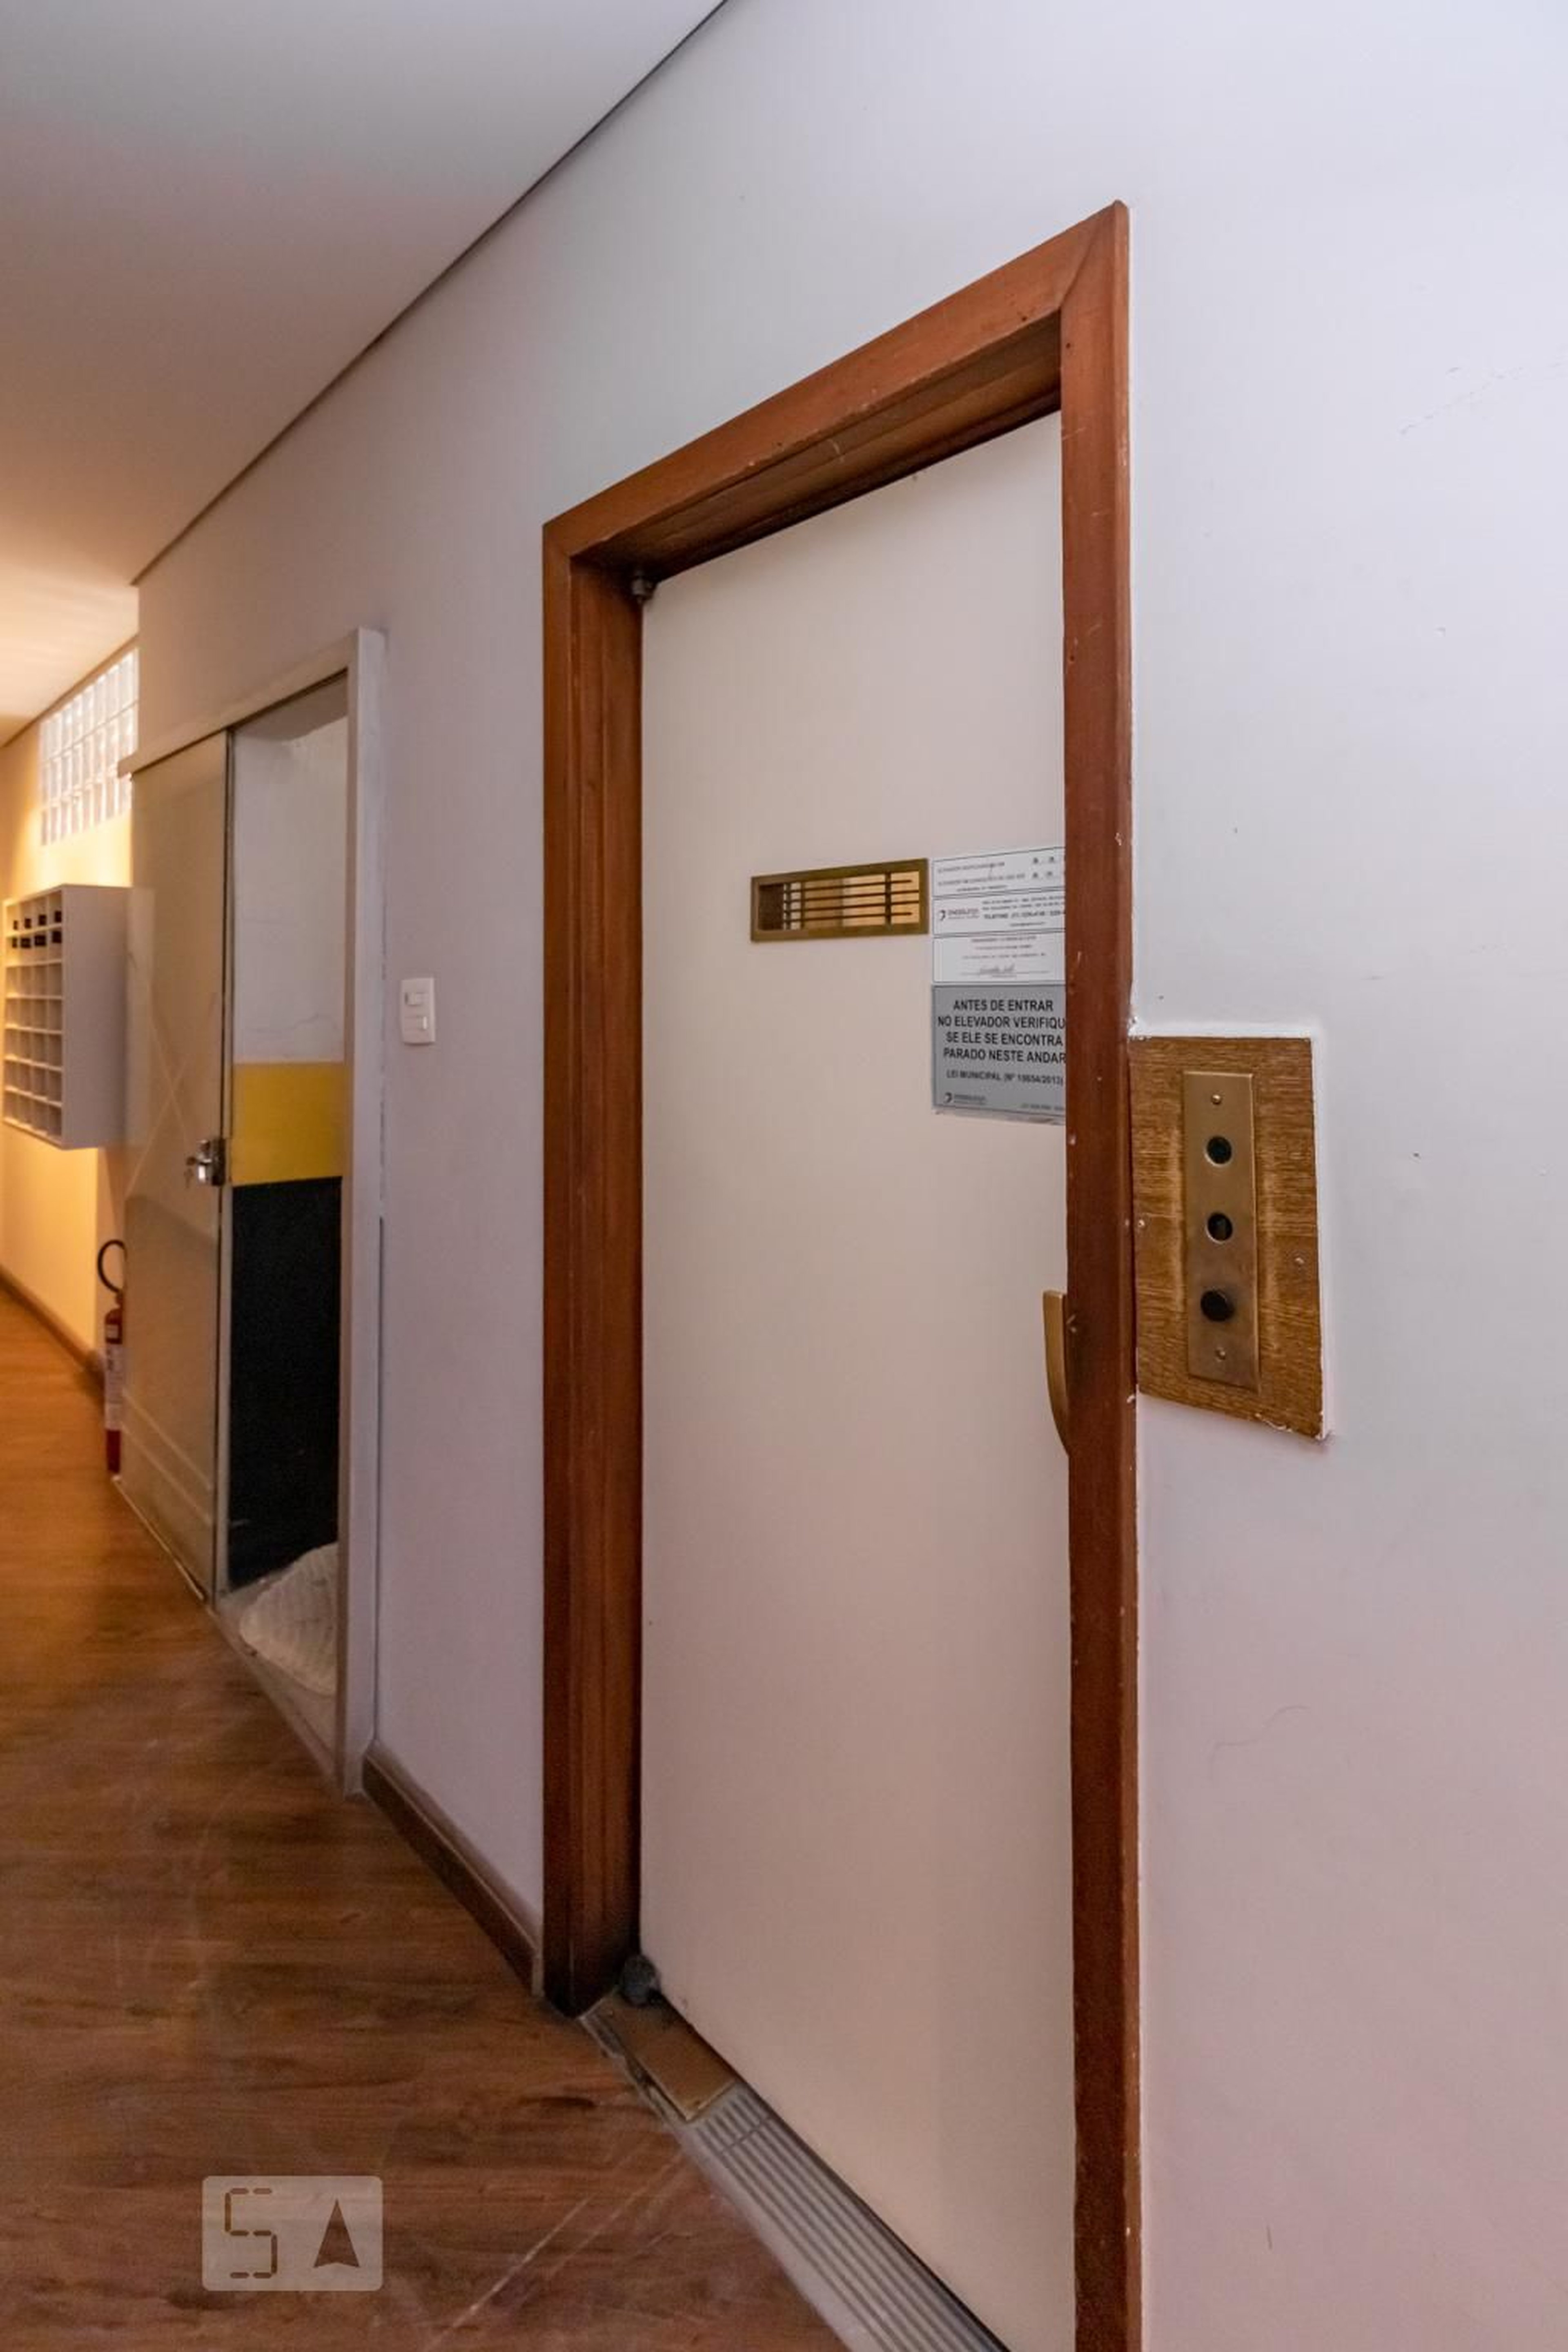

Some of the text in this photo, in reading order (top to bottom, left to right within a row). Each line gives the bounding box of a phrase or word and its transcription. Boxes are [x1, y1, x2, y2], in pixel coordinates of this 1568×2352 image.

[953, 1000, 1054, 1011] ANTES DE ENTRAR
[938, 1015, 1066, 1029] NO ELEVADOR VERIFIQU
[946, 1031, 1063, 1046] SE ELE SE ENCONTRA
[943, 1047, 1067, 1063] PARADO NESTE ANDAR
[946, 1069, 958, 1078] LEI
